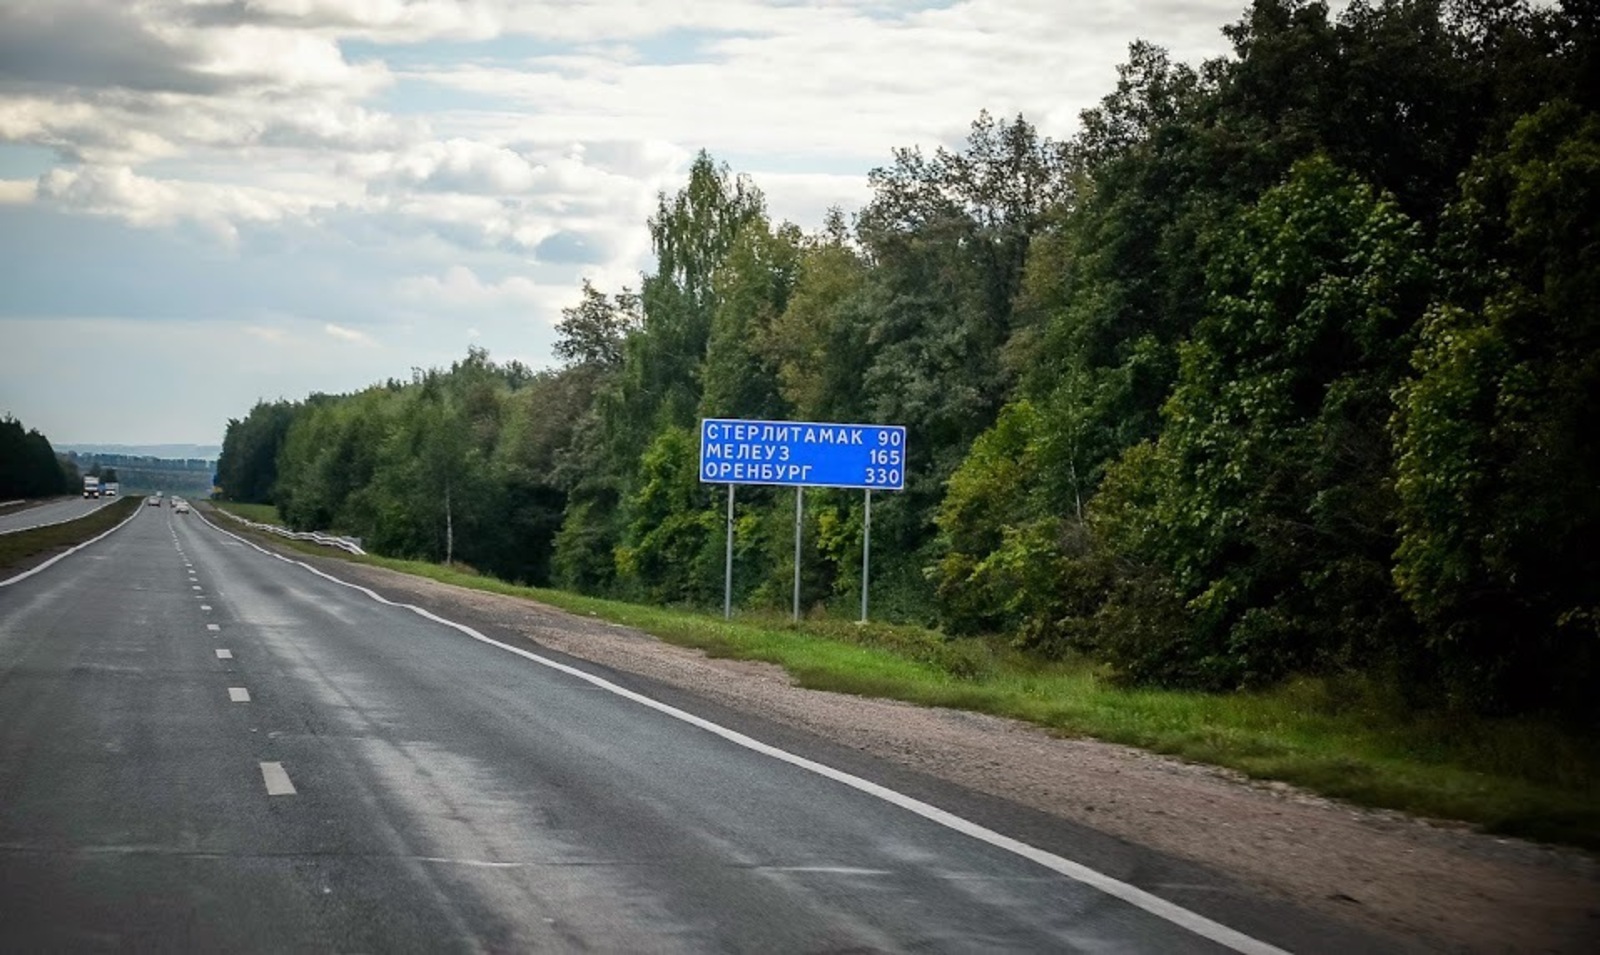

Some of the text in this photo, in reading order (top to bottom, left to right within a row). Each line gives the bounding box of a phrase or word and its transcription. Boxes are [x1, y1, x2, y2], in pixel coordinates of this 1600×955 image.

[707, 424, 901, 447] СТЕРЛИТАМАК 90
[706, 443, 901, 465] МЕЛЕУЗ 165
[705, 462, 899, 484] ОРЕНБУРГ 330
